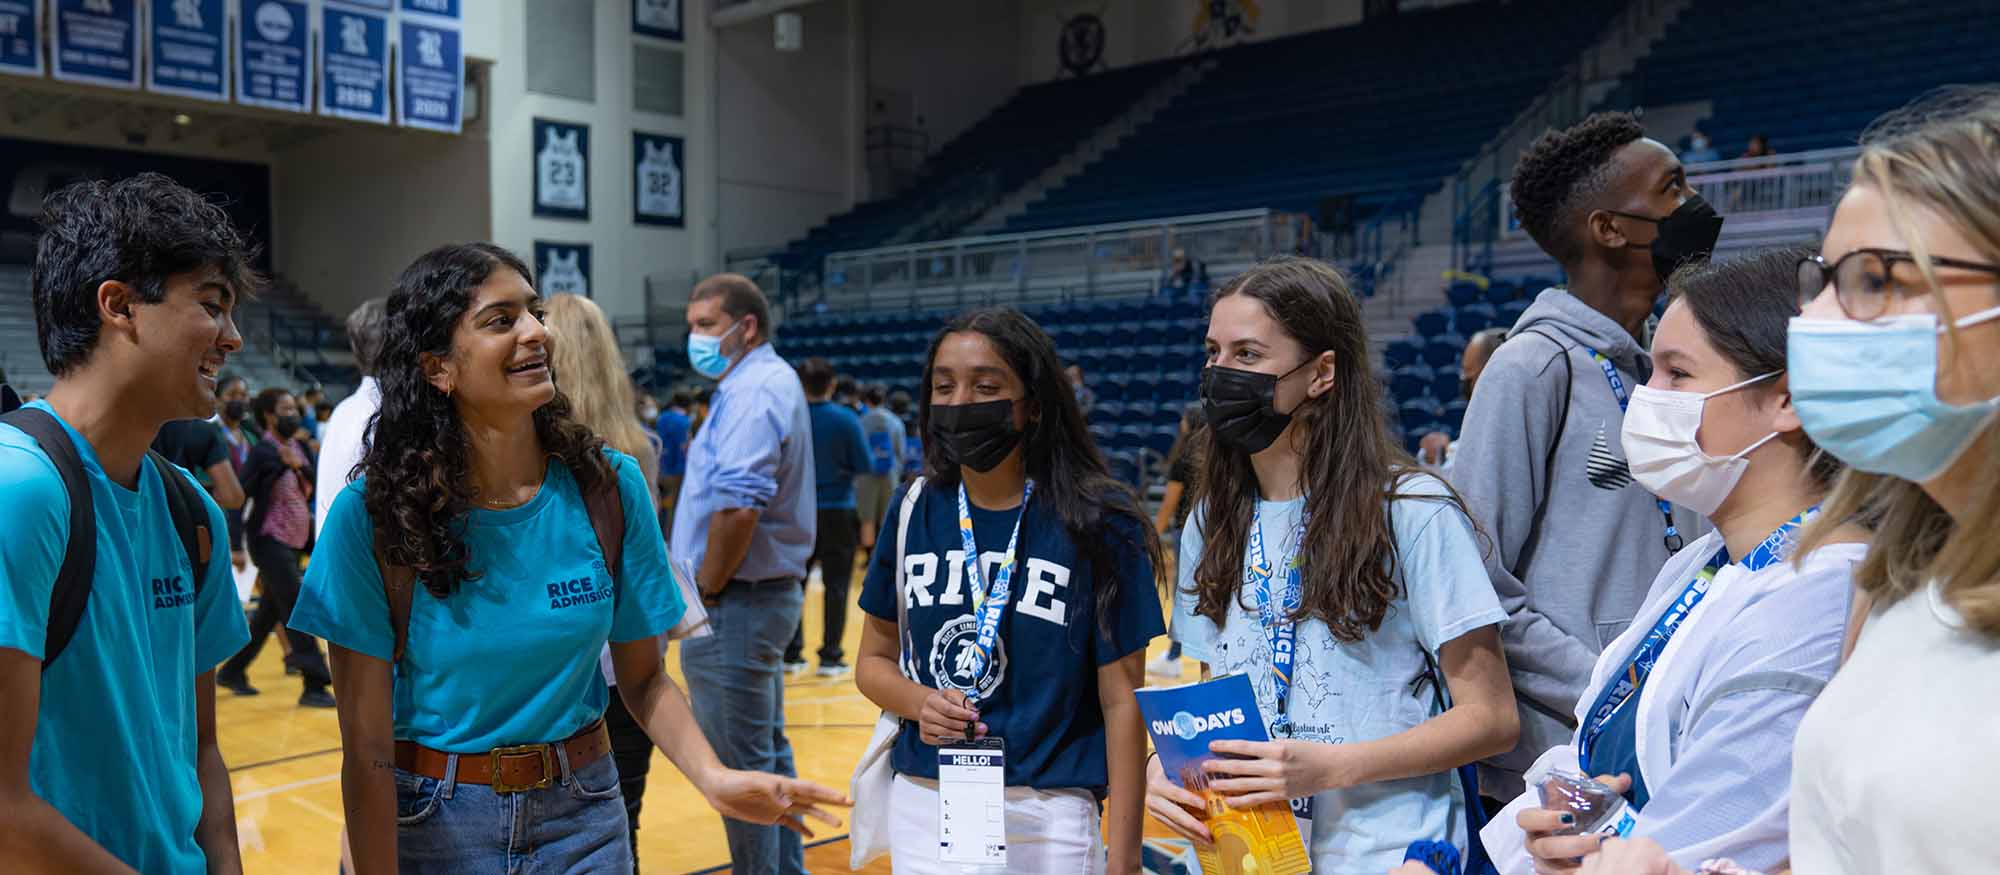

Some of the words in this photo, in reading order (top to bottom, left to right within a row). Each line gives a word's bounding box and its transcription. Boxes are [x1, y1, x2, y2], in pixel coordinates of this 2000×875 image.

[550, 161, 576, 187] 23
[648, 171, 672, 197] 32
[152, 575, 184, 596] RIC
[546, 577, 593, 600] RICE
[977, 606, 1001, 648] RICE
[1274, 617, 1295, 665] RICE
[1194, 707, 1245, 734] DAYS
[952, 755, 991, 766] HELLO!
